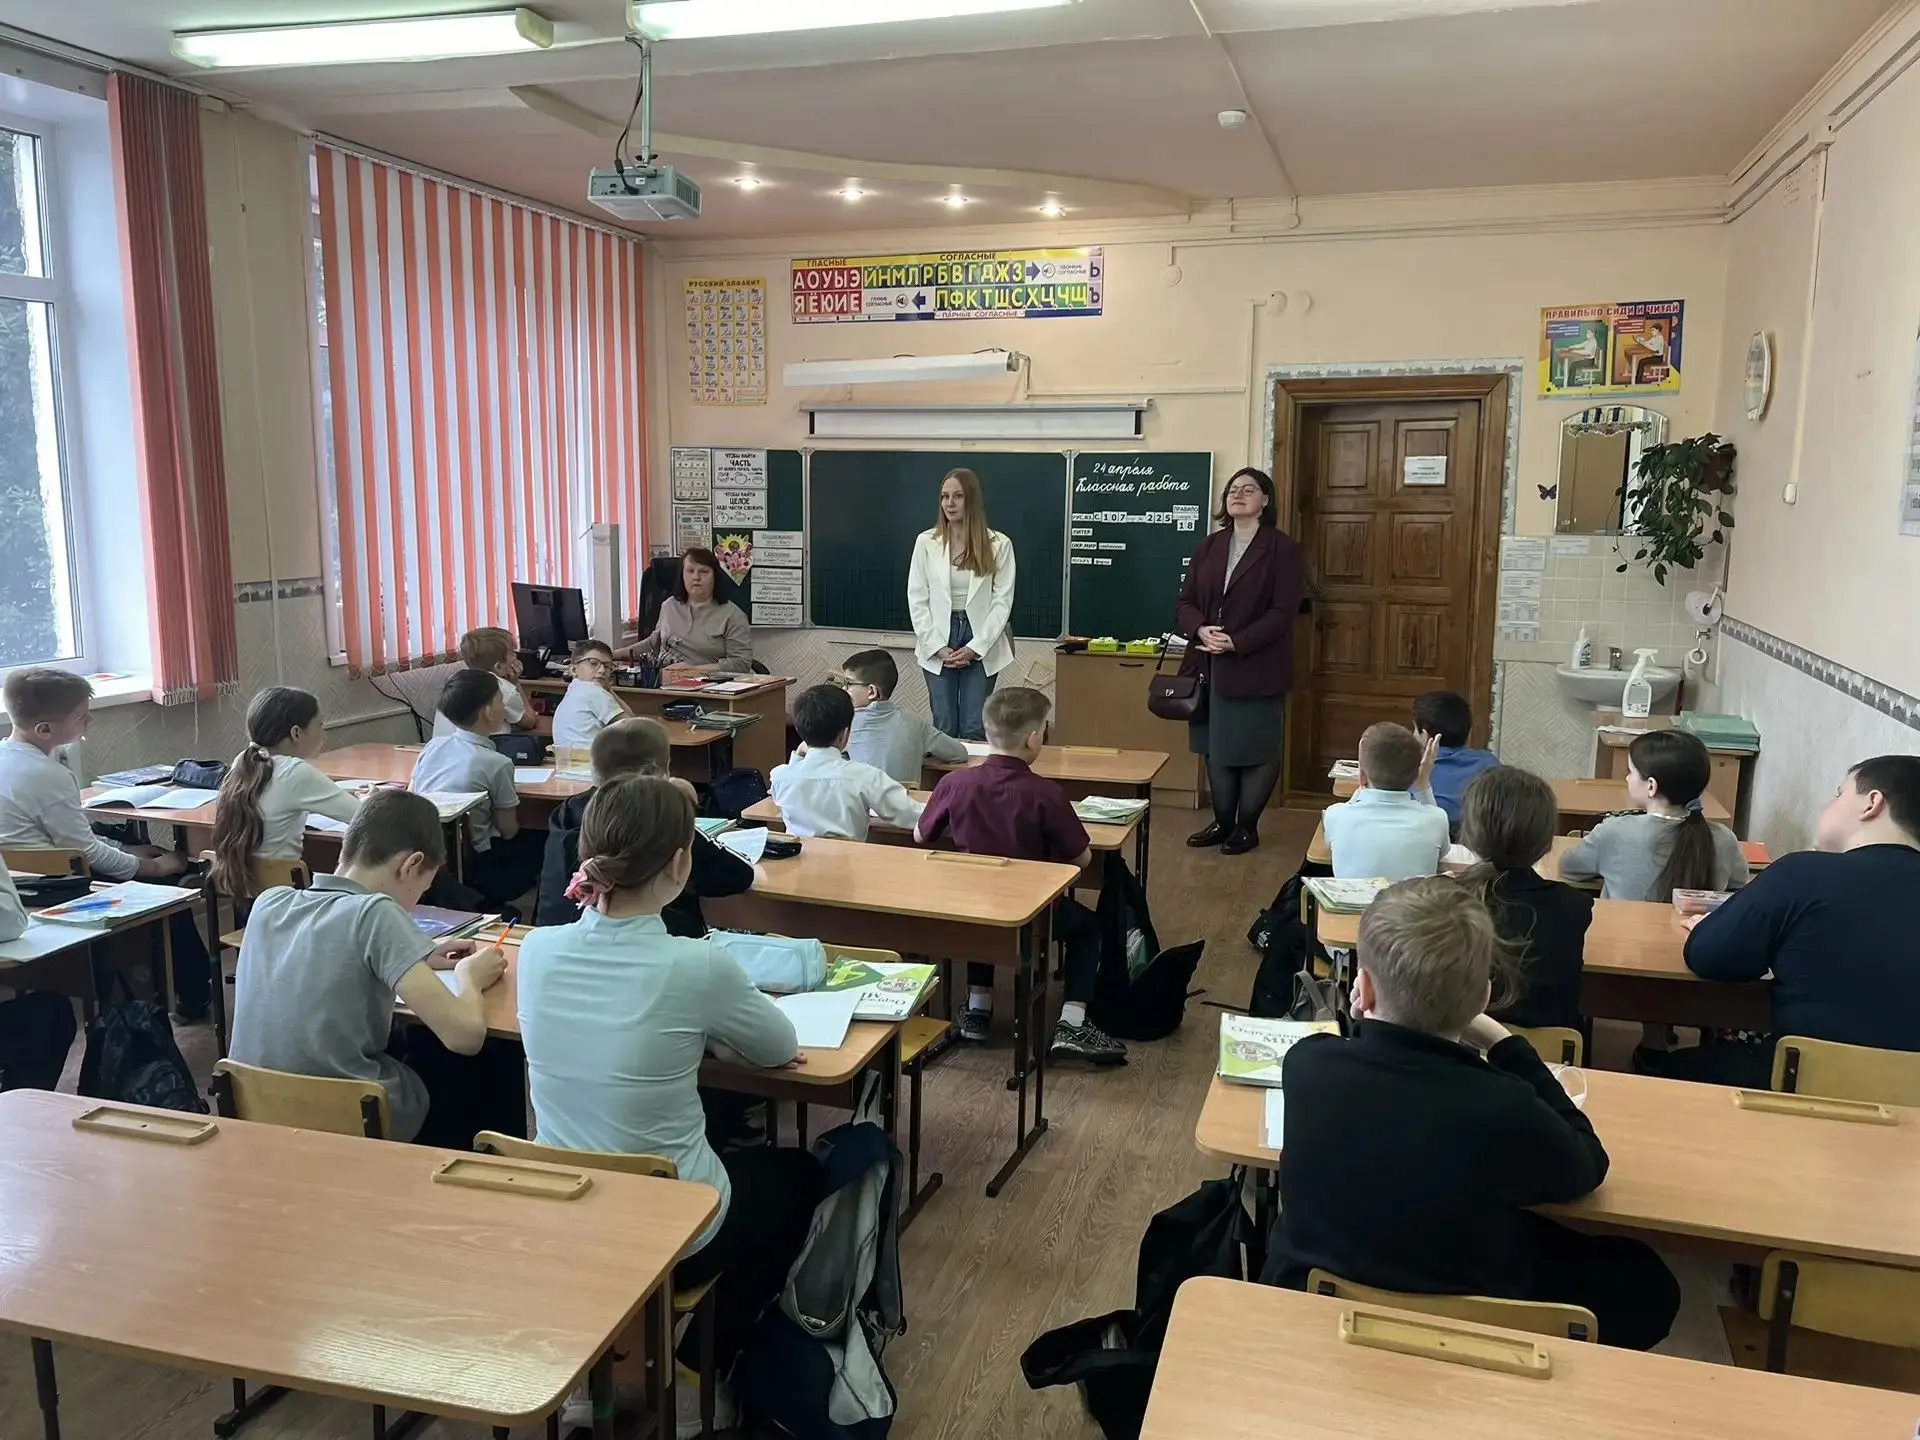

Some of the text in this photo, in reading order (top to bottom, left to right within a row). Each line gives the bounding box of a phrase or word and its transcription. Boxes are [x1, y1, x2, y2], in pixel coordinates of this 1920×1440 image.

[939, 252, 997, 262] СОГЛАСНЫЕ
[807, 258, 847, 268] ГЛАСНЫЕ
[688, 279, 760, 288] РУССКИЙ АЛФАВИТ
[975, 310, 1018, 318] СОГЛАСНЫЕ
[1545, 301, 1680, 319] ПРАВИЛЬНО СИДИ И ЧИТАЙ
[729, 459, 751, 467] ЧАСТЬ
[1093, 457, 1155, 480] 24 апреля
[1075, 474, 1190, 496] Классная работа
[729, 497, 751, 505] ЦЕЛОЕ
[1103, 513, 1126, 521] 107
[1147, 514, 1171, 522] 225
